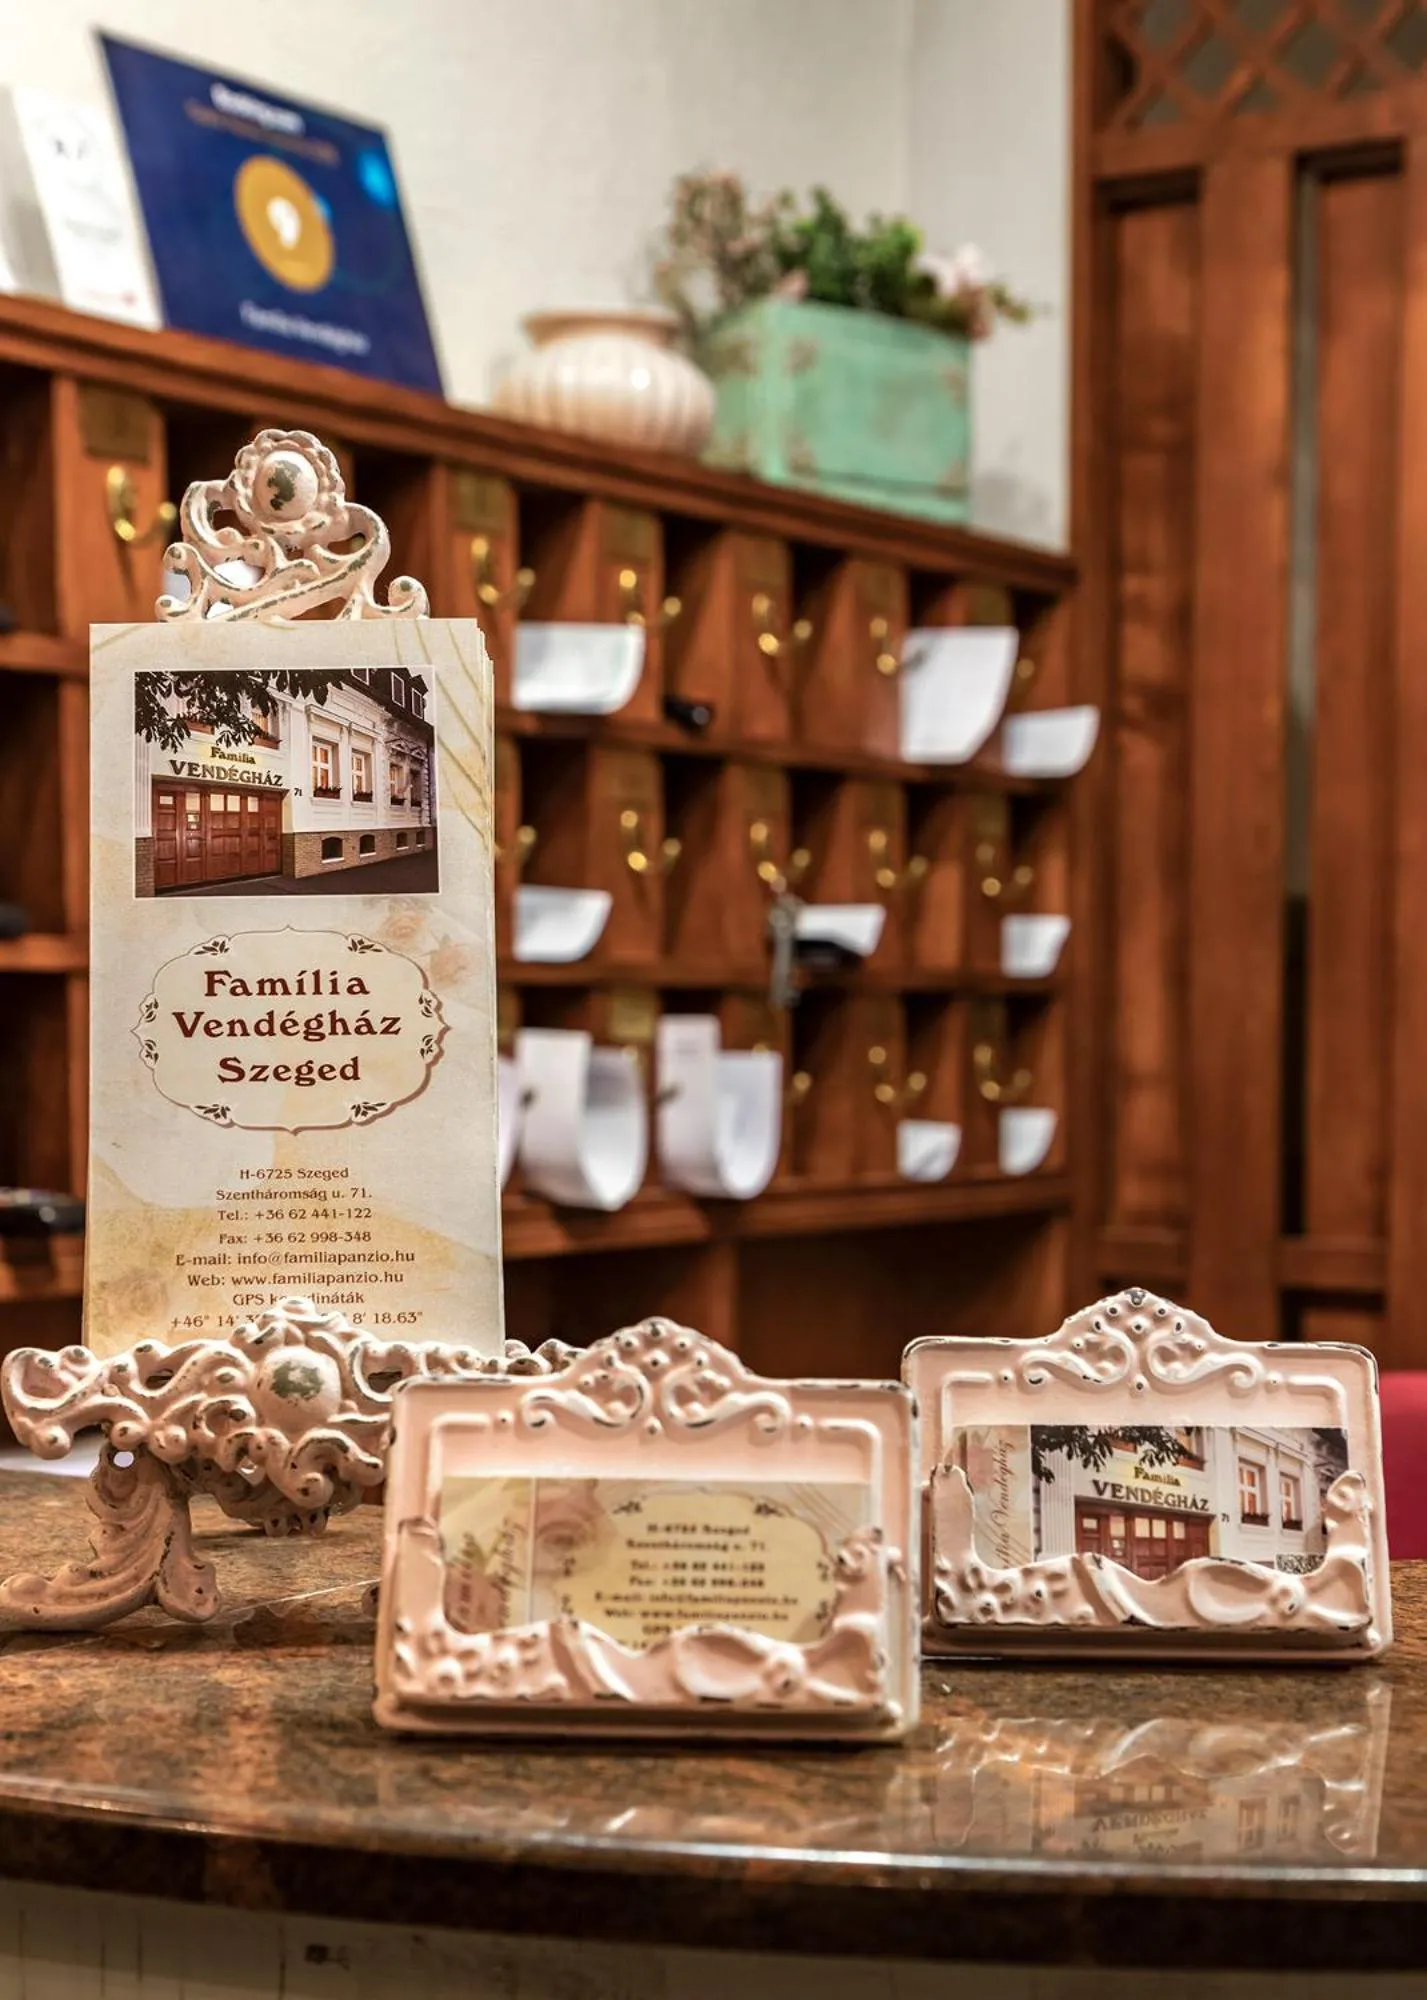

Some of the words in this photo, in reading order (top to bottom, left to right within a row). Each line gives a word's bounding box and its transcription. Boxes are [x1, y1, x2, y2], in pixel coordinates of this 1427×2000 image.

[169, 760, 283, 786] VENDÉGHÁZ
[204, 970, 371, 998] Família
[172, 1009, 402, 1042] Vendégház
[217, 1056, 361, 1087] Szeged
[240, 1168, 292, 1180] H-6725
[297, 1168, 349, 1181] Szeged
[216, 1187, 328, 1201] Szentháromság
[331, 1189, 345, 1199] u.
[350, 1187, 373, 1199] 71.
[217, 1209, 249, 1221] Tel.:
[255, 1209, 285, 1221] +36
[288, 1208, 307, 1220] 62
[311, 1207, 372, 1219] 441-122
[219, 1233, 248, 1245] Fax:
[254, 1232, 284, 1244] +36
[287, 1231, 306, 1243] 62
[310, 1231, 372, 1243] 998-348
[175, 1253, 232, 1267] E-mail:
[237, 1250, 416, 1266] info@familiapanzio.hu
[187, 1273, 226, 1287] Web:
[231, 1271, 404, 1287] www.familiapanzio.hu
[233, 1293, 264, 1306] GPS
[1091, 1479, 1210, 1512] VENDÉGHÁZ
